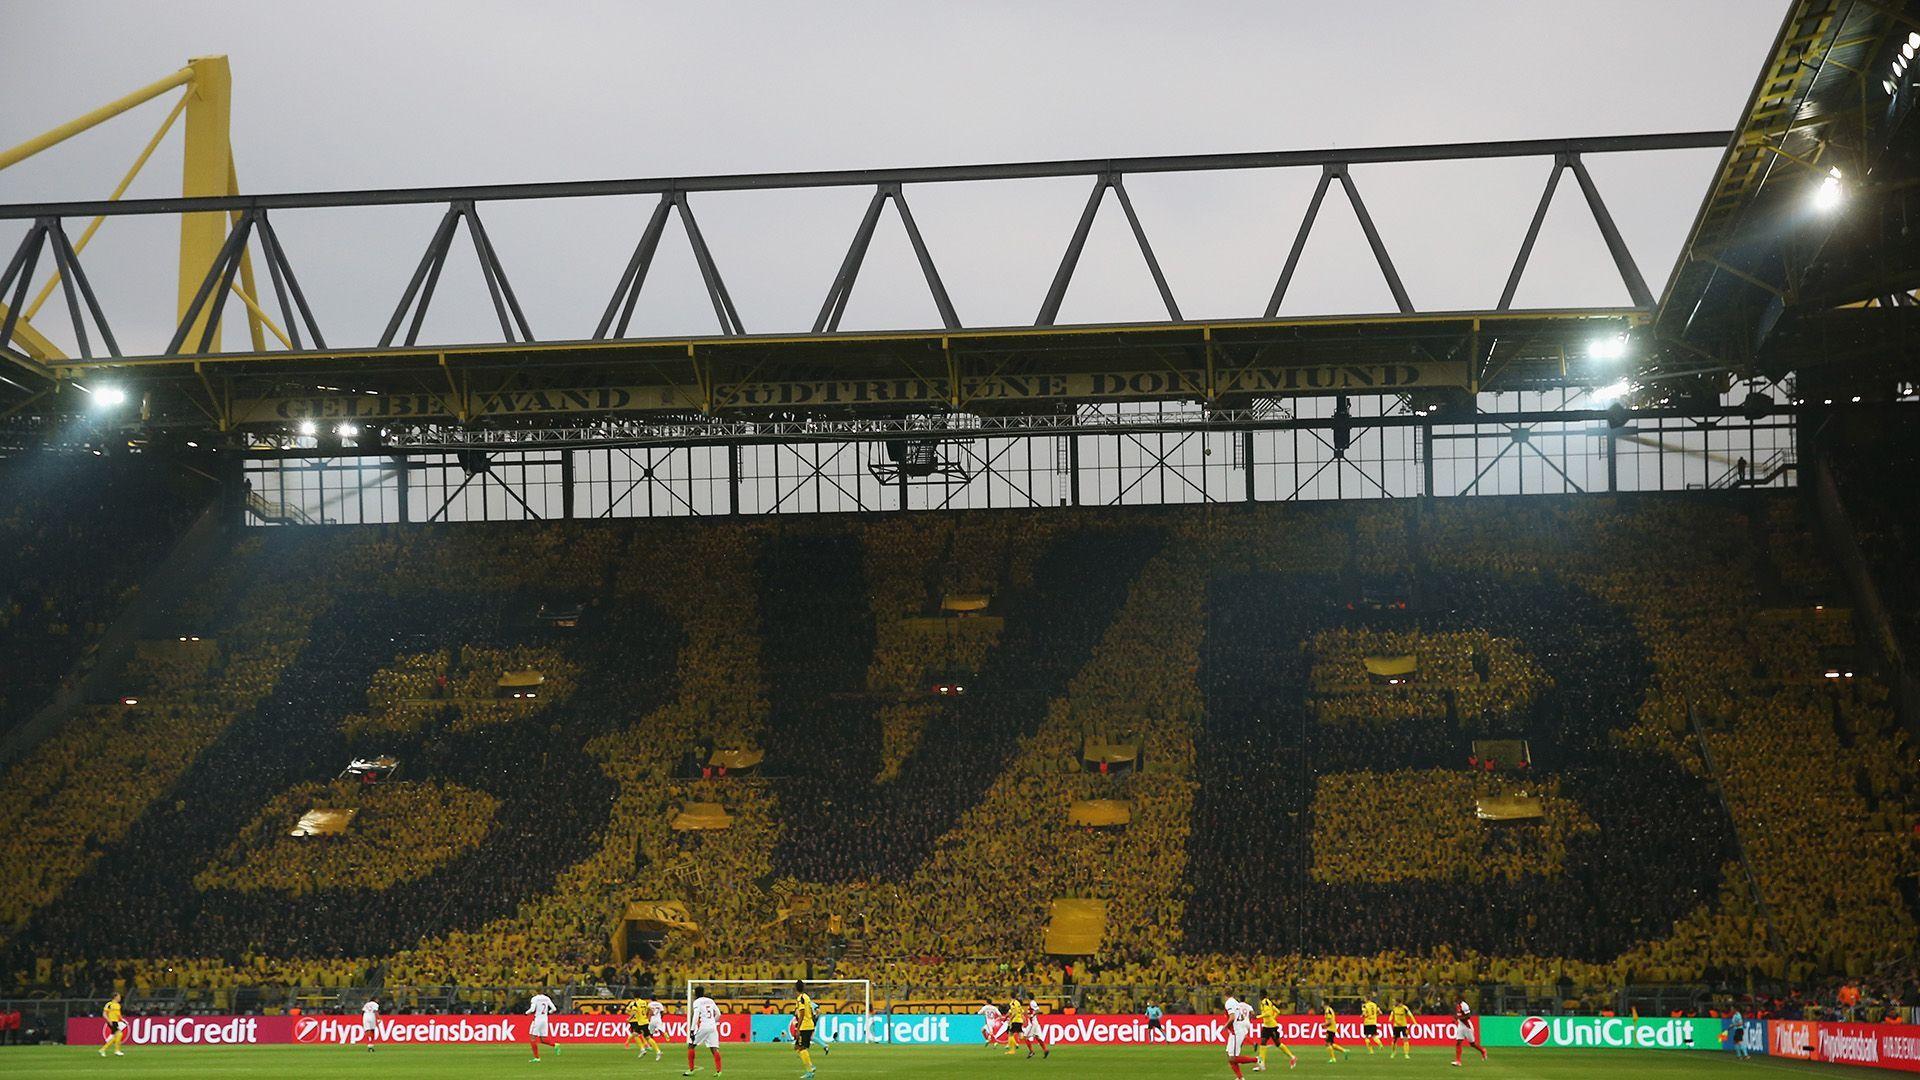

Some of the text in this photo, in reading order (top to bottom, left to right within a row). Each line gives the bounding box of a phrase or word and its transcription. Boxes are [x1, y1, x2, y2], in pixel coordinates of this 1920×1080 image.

[276, 396, 445, 418] GELBE
[478, 387, 631, 413] WAND
[1089, 364, 1421, 394] DORTMUND
[132, 1018, 257, 1043] UniCredit
[819, 1016, 950, 1043] UniCredit
[1033, 1018, 1226, 1045] ypoVereinsbank
[1553, 1018, 1695, 1047] UniCredit
